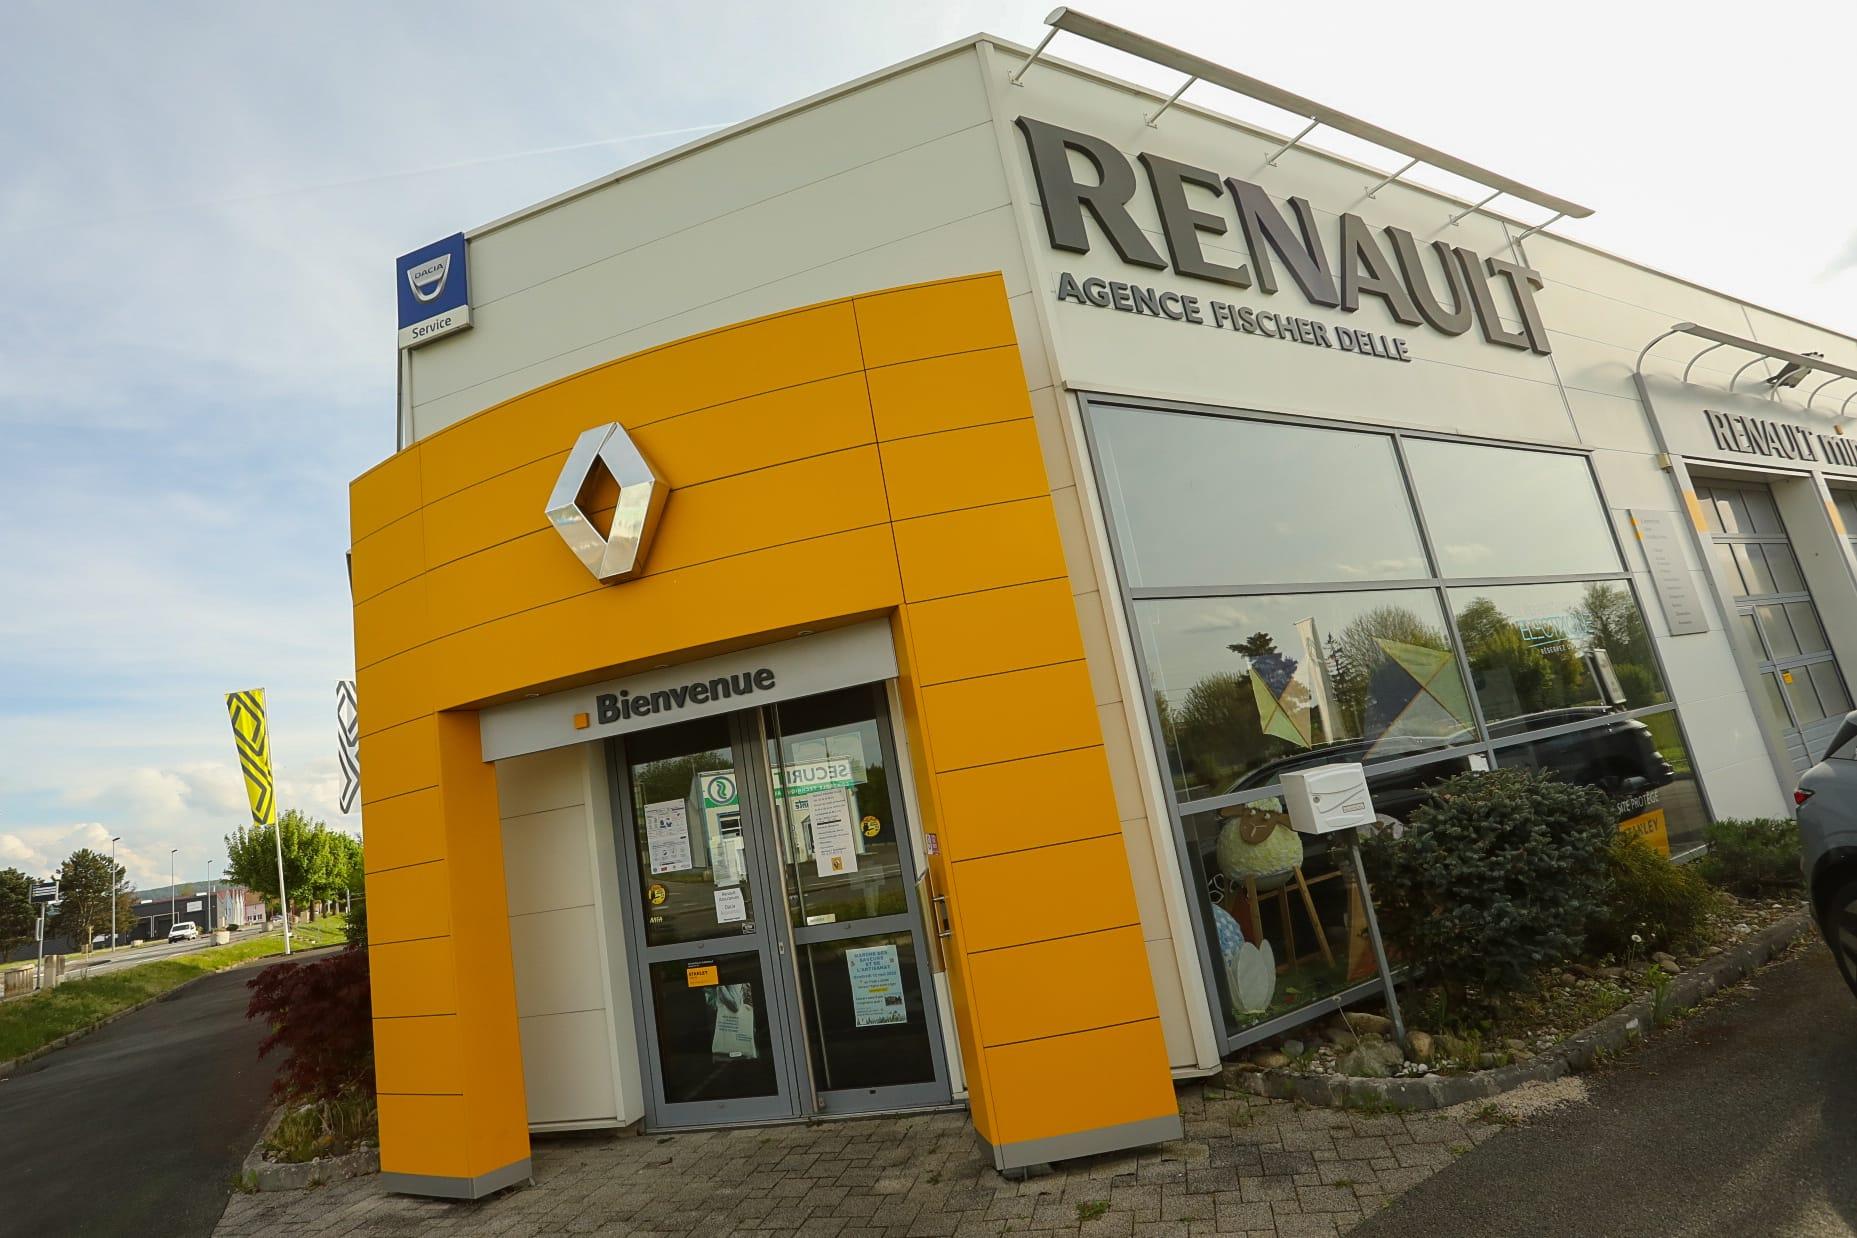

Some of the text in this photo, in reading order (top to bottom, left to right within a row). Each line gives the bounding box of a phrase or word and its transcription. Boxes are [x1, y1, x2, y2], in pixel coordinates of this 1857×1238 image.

[1015, 116, 1552, 356] RENAULT
[414, 263, 444, 279] DACIA
[412, 317, 452, 339] Service
[1057, 272, 1411, 362] AGENCE FISCHER DELLE
[1704, 409, 1819, 461] RENAULT
[596, 668, 776, 724] Bienvenue
[1616, 799, 1631, 815] SITE
